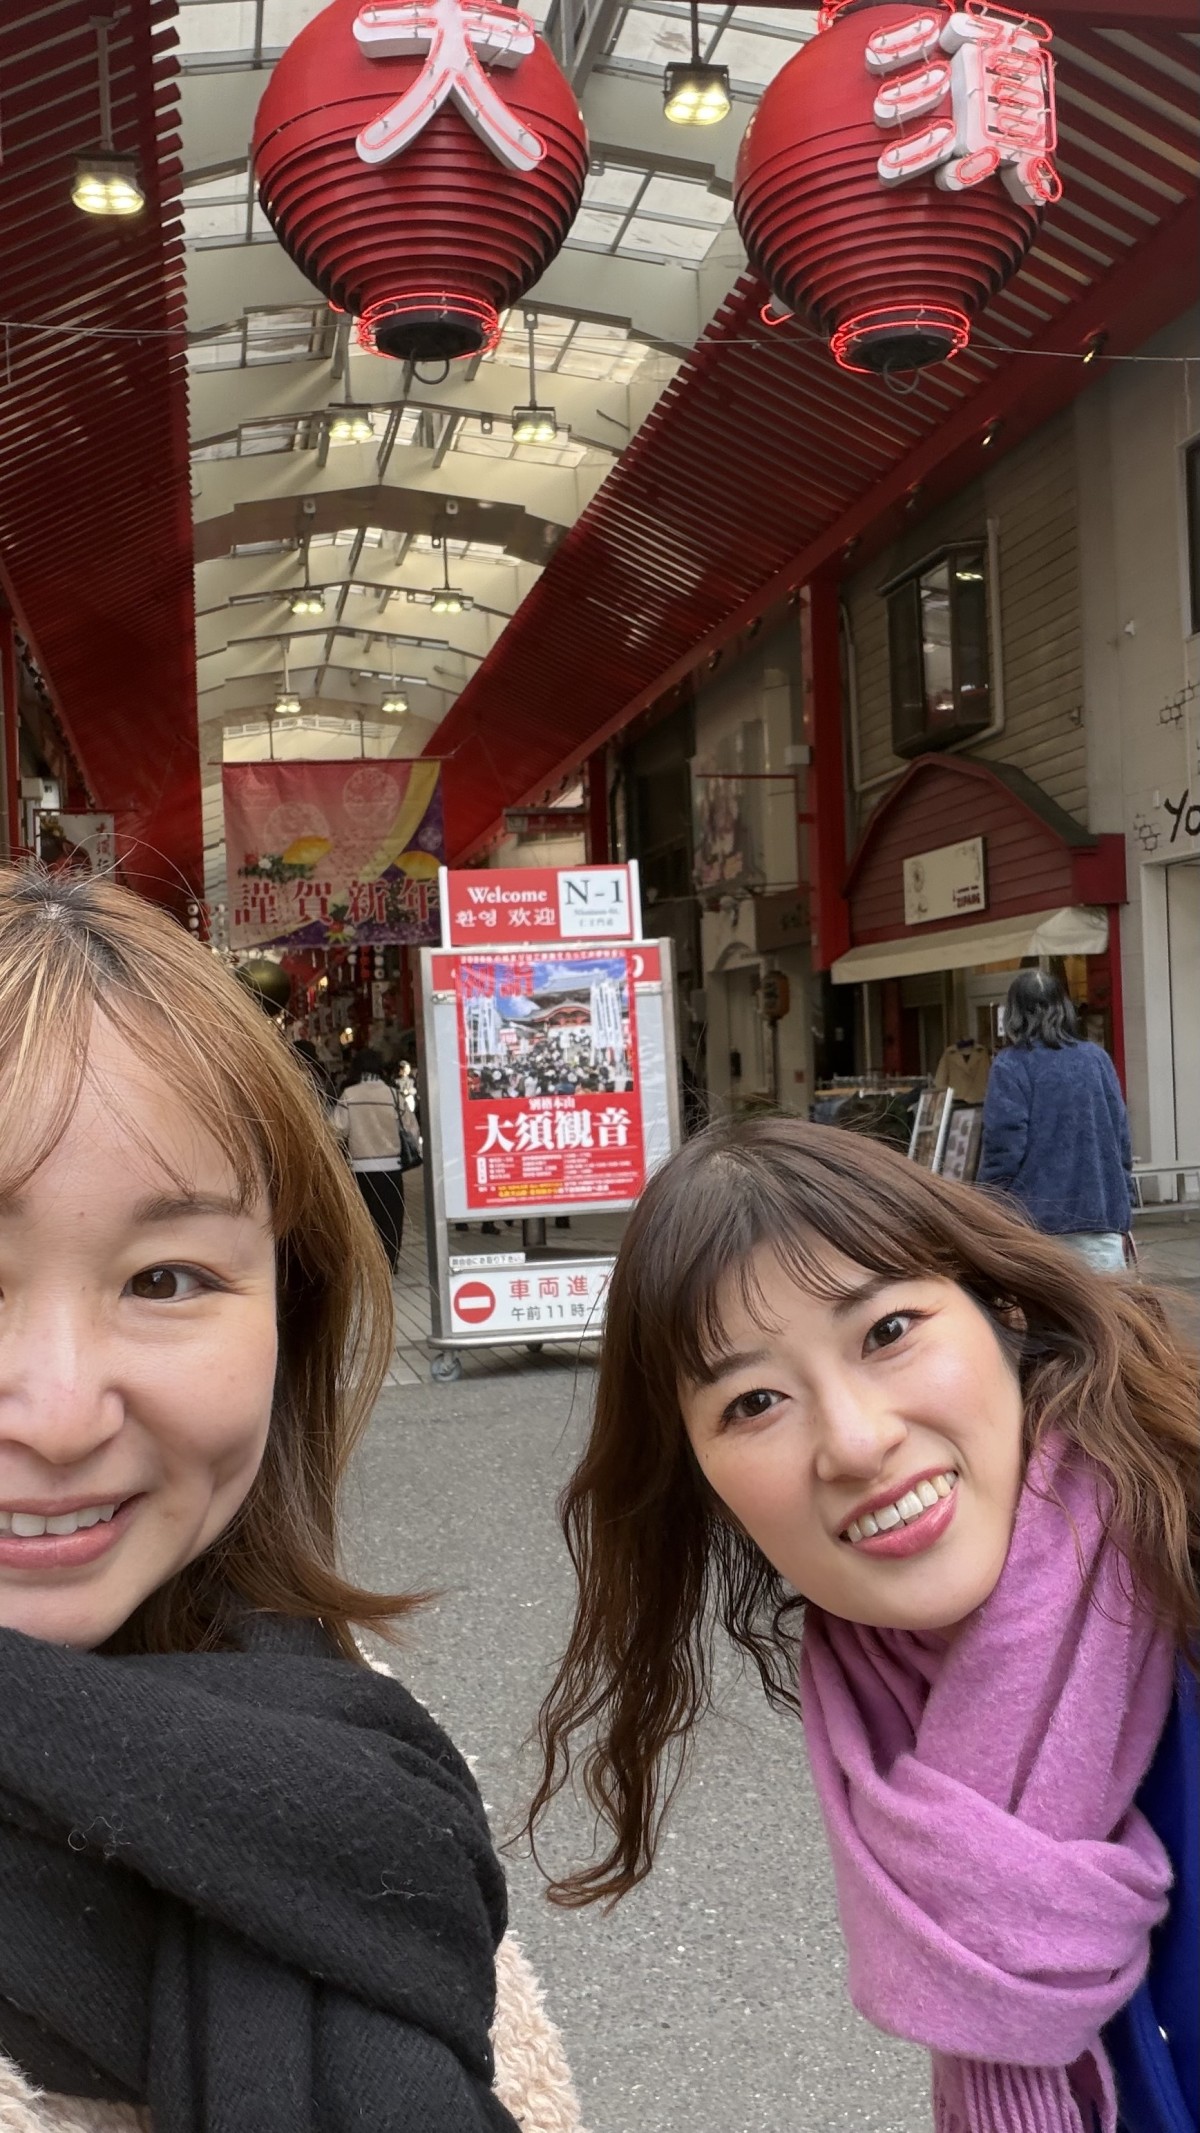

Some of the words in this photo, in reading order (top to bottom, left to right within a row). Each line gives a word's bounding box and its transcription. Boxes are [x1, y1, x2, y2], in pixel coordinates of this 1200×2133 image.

[353, 0, 547, 172] 大
[234, 878, 441, 926] 謹賀新年
[467, 886, 548, 904] Welcome
[564, 879, 623, 906] N-1
[455, 908, 497, 927] 환영
[508, 907, 556, 927] 欢迎
[475, 1107, 632, 1154] 大須観音
